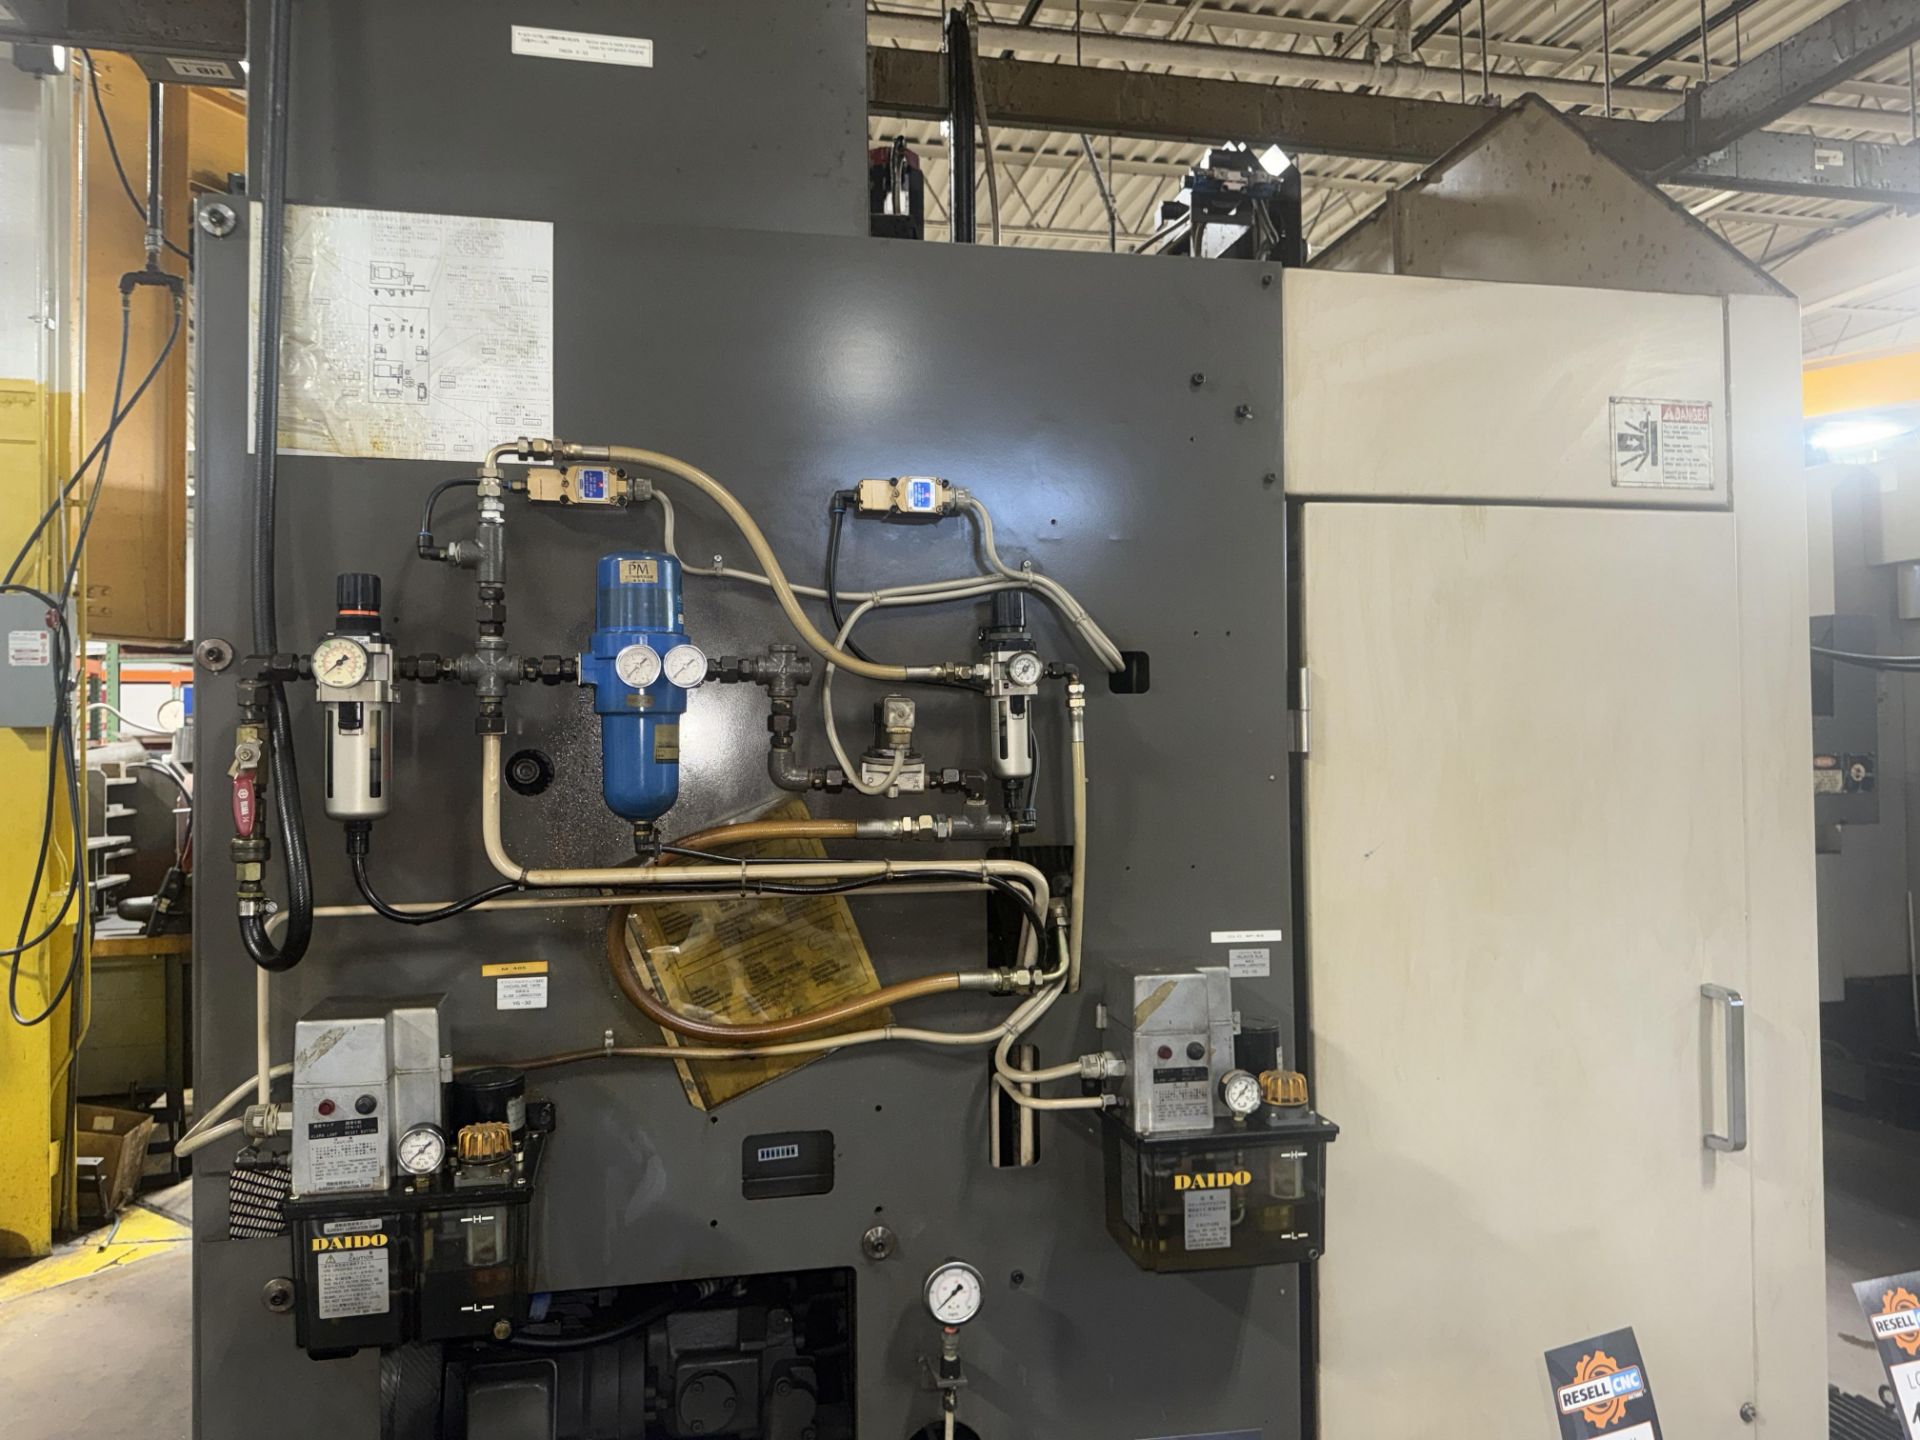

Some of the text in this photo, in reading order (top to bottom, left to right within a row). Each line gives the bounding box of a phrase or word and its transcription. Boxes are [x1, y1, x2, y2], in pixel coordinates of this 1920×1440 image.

[1674, 406, 1708, 421] DANGER
[628, 563, 649, 575] PM
[1173, 1171, 1252, 1190] DAIDO
[312, 1233, 388, 1252] DAIDO
[1875, 1315, 1916, 1334] RESELL
[1562, 1371, 1641, 1407] RESELL CNC
